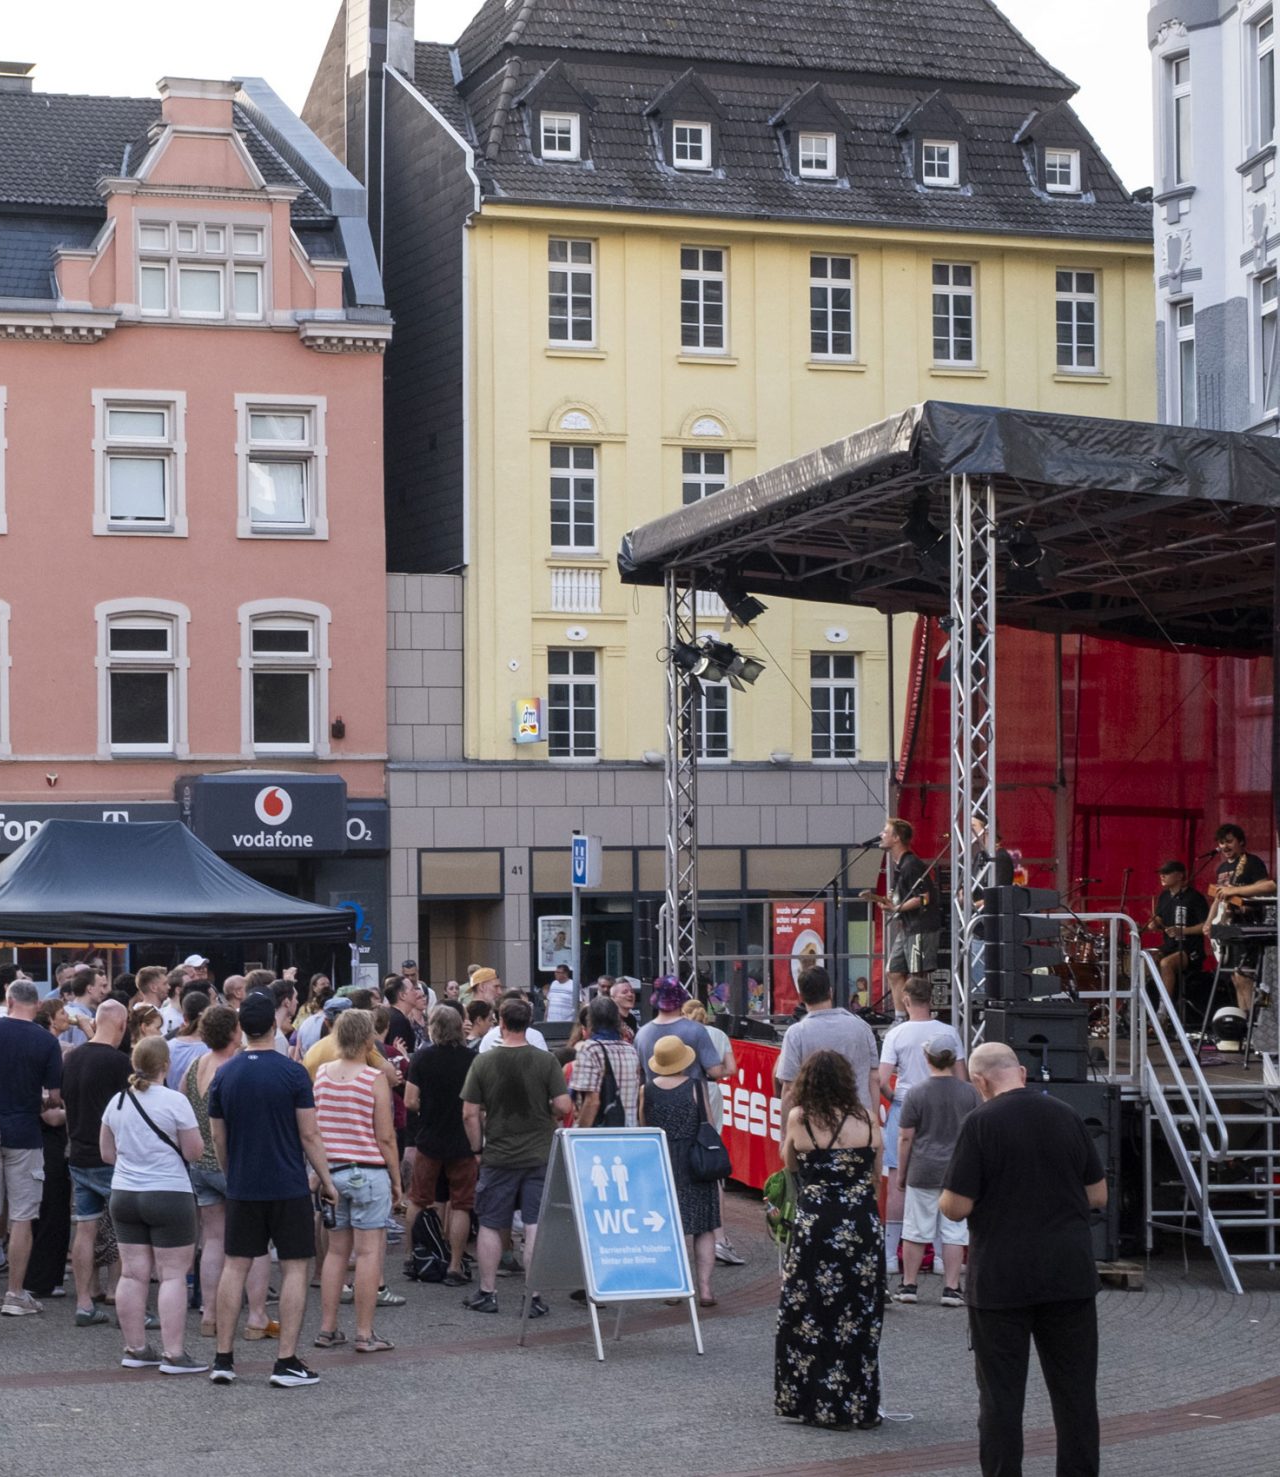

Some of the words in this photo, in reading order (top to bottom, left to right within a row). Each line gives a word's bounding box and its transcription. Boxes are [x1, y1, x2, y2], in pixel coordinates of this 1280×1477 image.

[232, 831, 314, 848] vodafone
[512, 865, 523, 876] 41
[593, 1208, 639, 1234] WC
